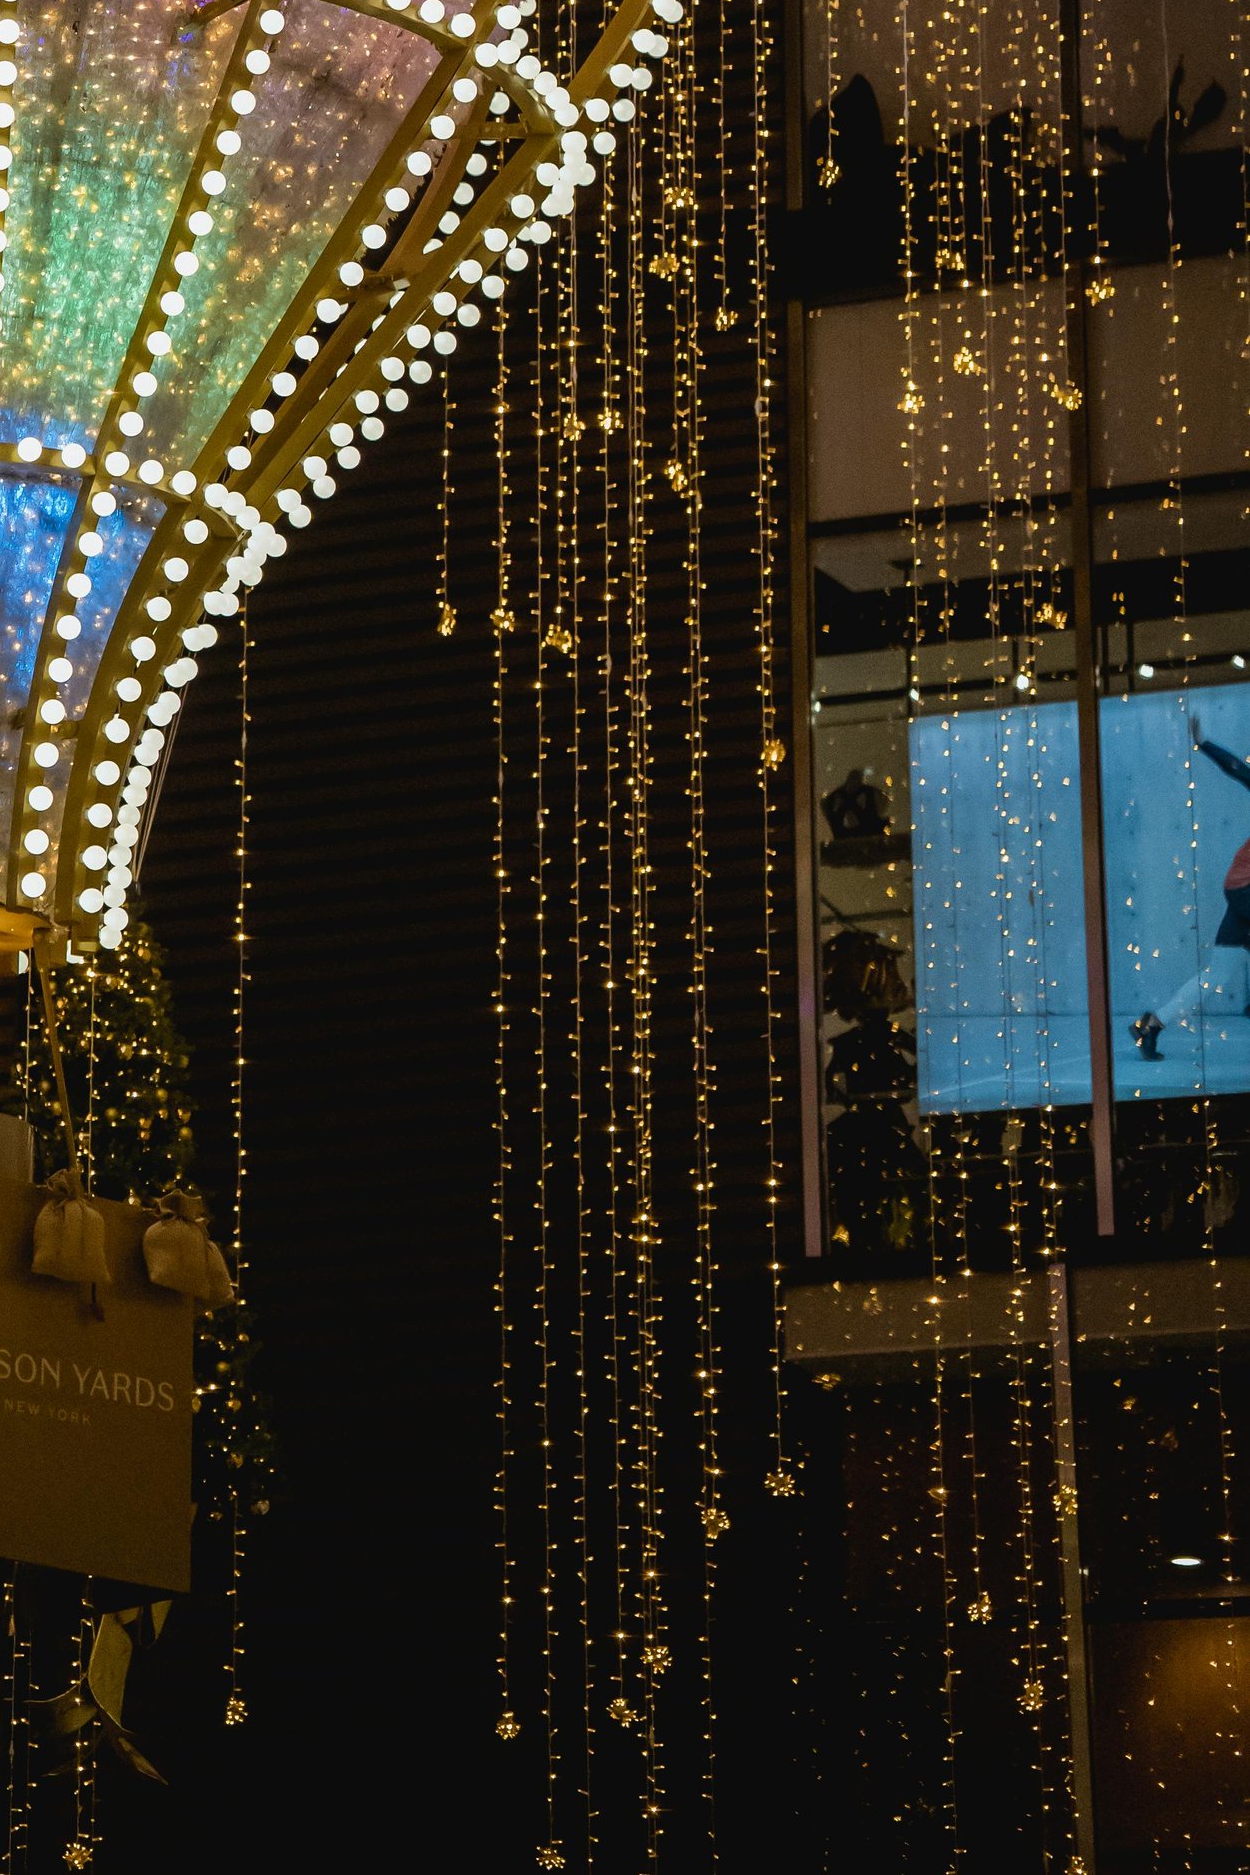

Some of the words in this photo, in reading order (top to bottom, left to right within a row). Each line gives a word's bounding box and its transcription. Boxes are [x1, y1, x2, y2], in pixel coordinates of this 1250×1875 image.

[71, 1362, 175, 1412] YARDS
[3, 1397, 41, 1417] NEW
[48, 1405, 92, 1427] YORK
